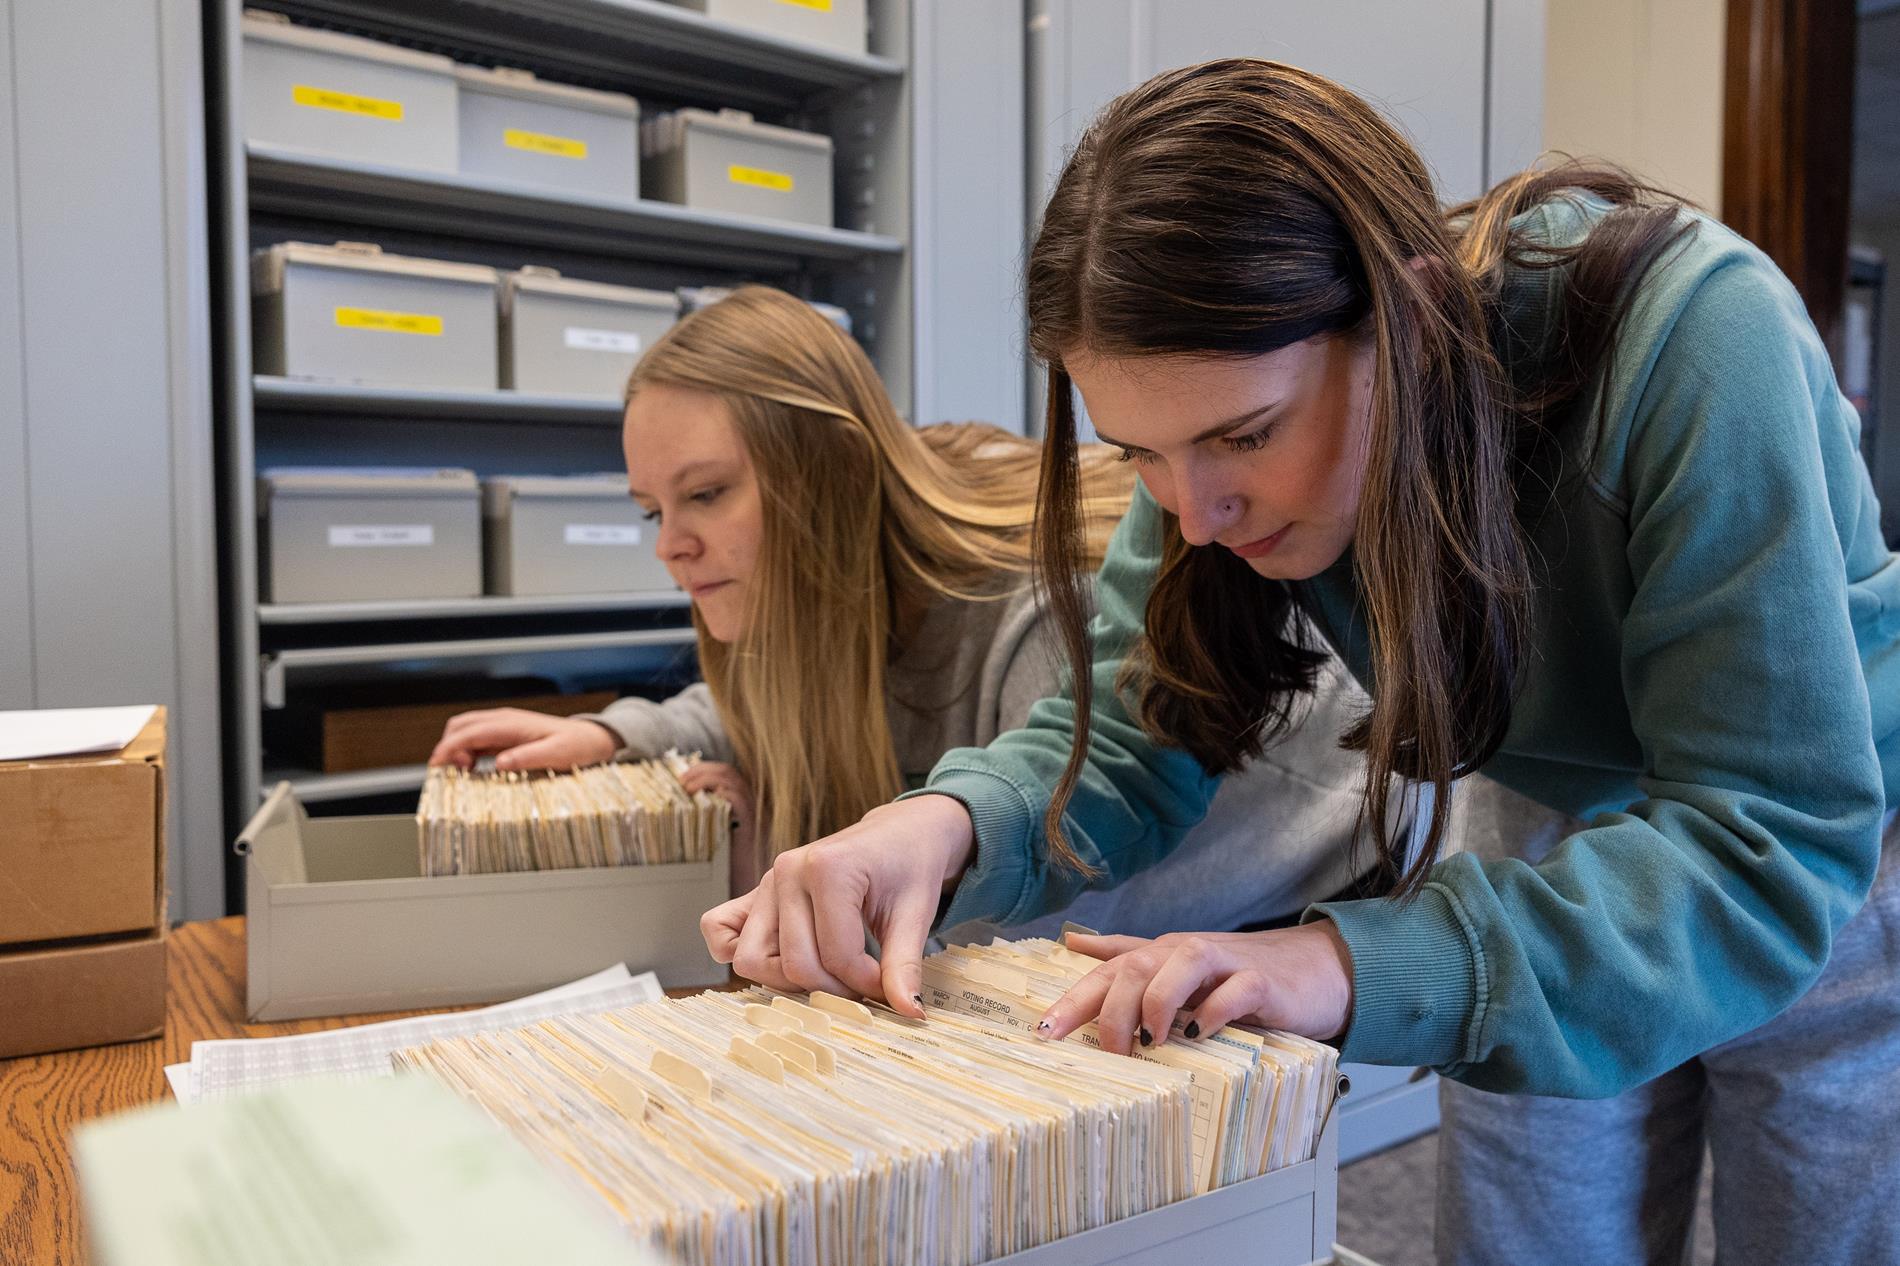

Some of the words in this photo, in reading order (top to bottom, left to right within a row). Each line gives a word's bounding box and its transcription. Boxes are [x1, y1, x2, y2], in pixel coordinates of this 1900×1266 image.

[933, 990, 950, 1001] MARCH
[962, 990, 985, 1004] VOTING
[985, 998, 1011, 1014] RECORD
[934, 999, 945, 1008] MAY
[969, 1003, 991, 1017] AUGUST
[1081, 1033, 1100, 1047] TRAN
